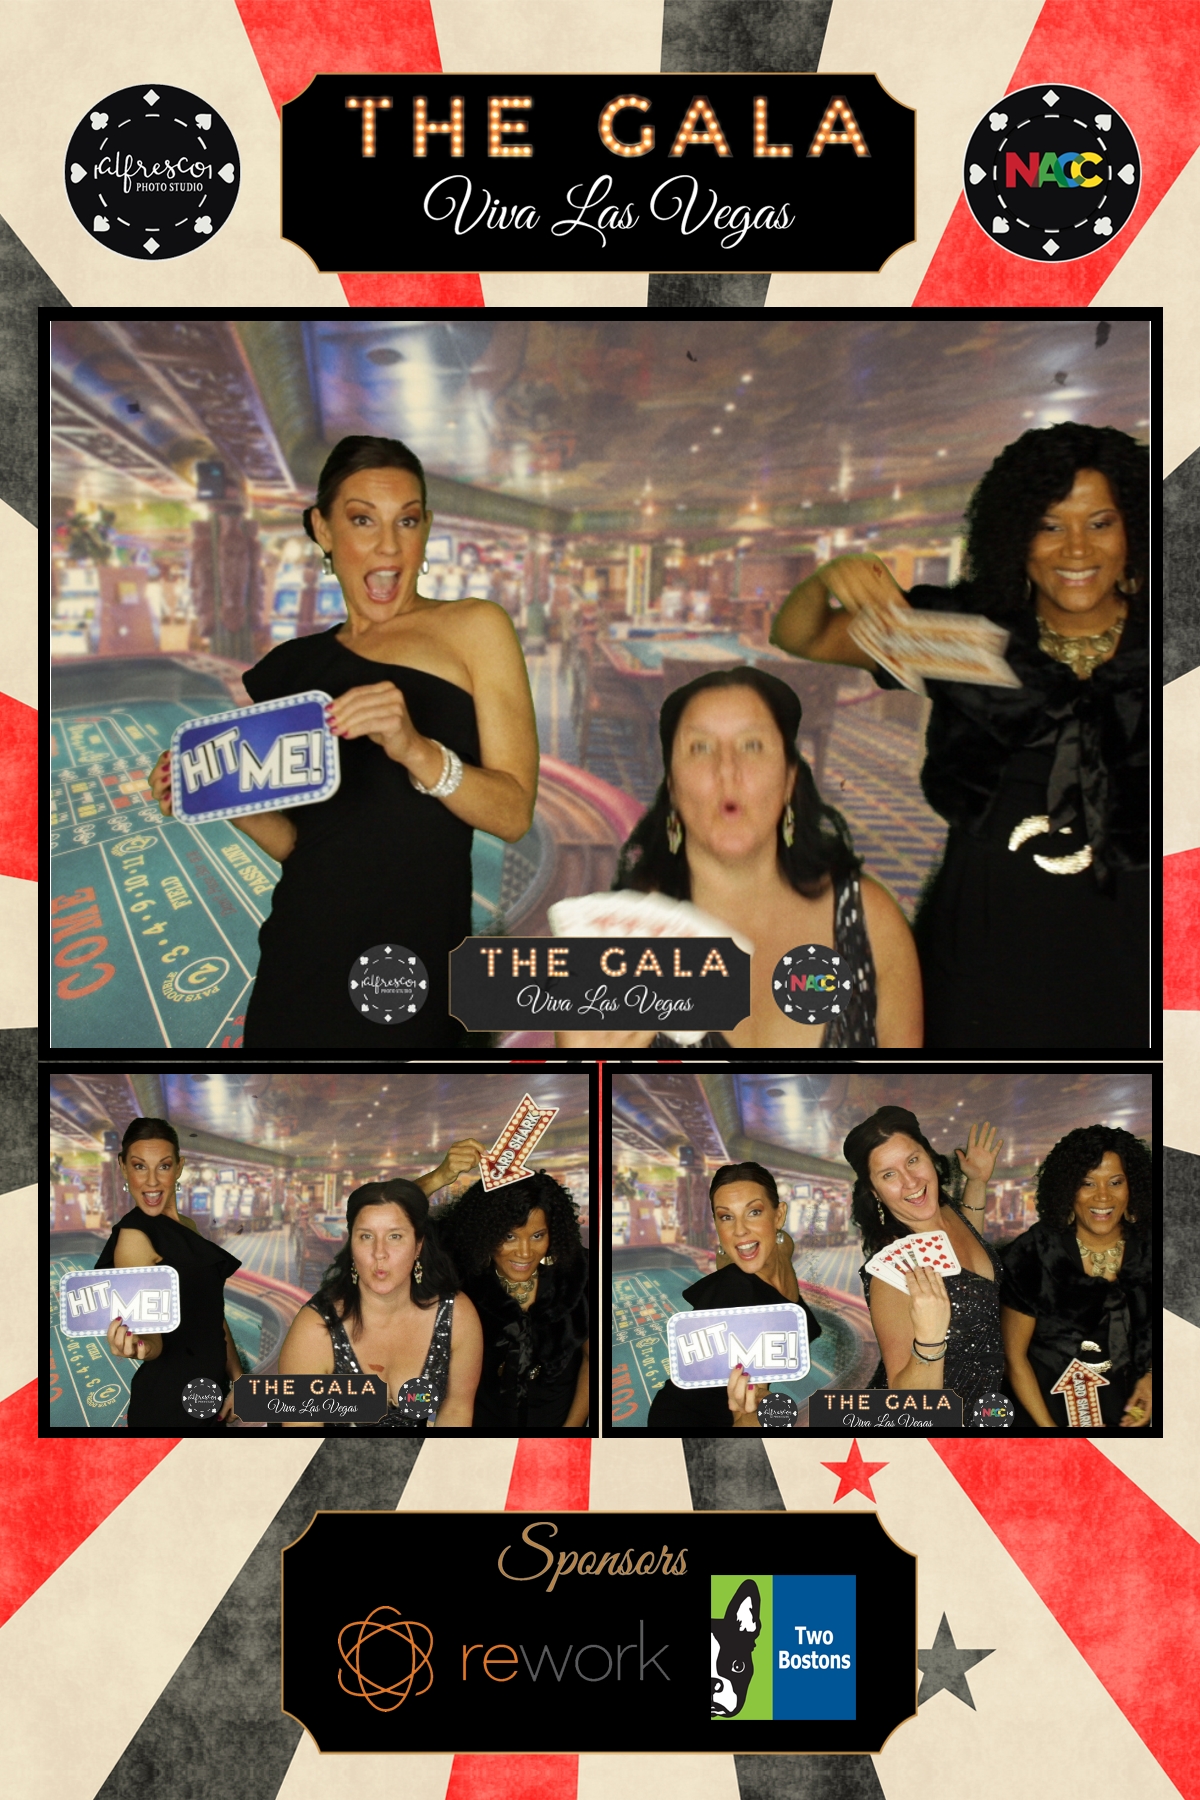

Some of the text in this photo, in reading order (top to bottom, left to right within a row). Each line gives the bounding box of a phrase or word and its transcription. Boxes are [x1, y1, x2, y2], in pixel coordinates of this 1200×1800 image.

[181, 726, 240, 794] HIT
[239, 728, 325, 793] ME!
[221, 843, 275, 896] PASS LINE
[160, 876, 192, 910] FIELD
[51, 886, 116, 1001] COME
[161, 945, 190, 964] 3
[161, 971, 220, 1003] PAYS DOUBLE
[188, 962, 219, 984] 2
[490, 1110, 541, 1180] CARD SHARK
[67, 1280, 111, 1318] HIT
[110, 1289, 171, 1322] ME!
[676, 1321, 728, 1366] HIT
[728, 1330, 798, 1369] ME!
[1072, 1371, 1087, 1398] CARD
